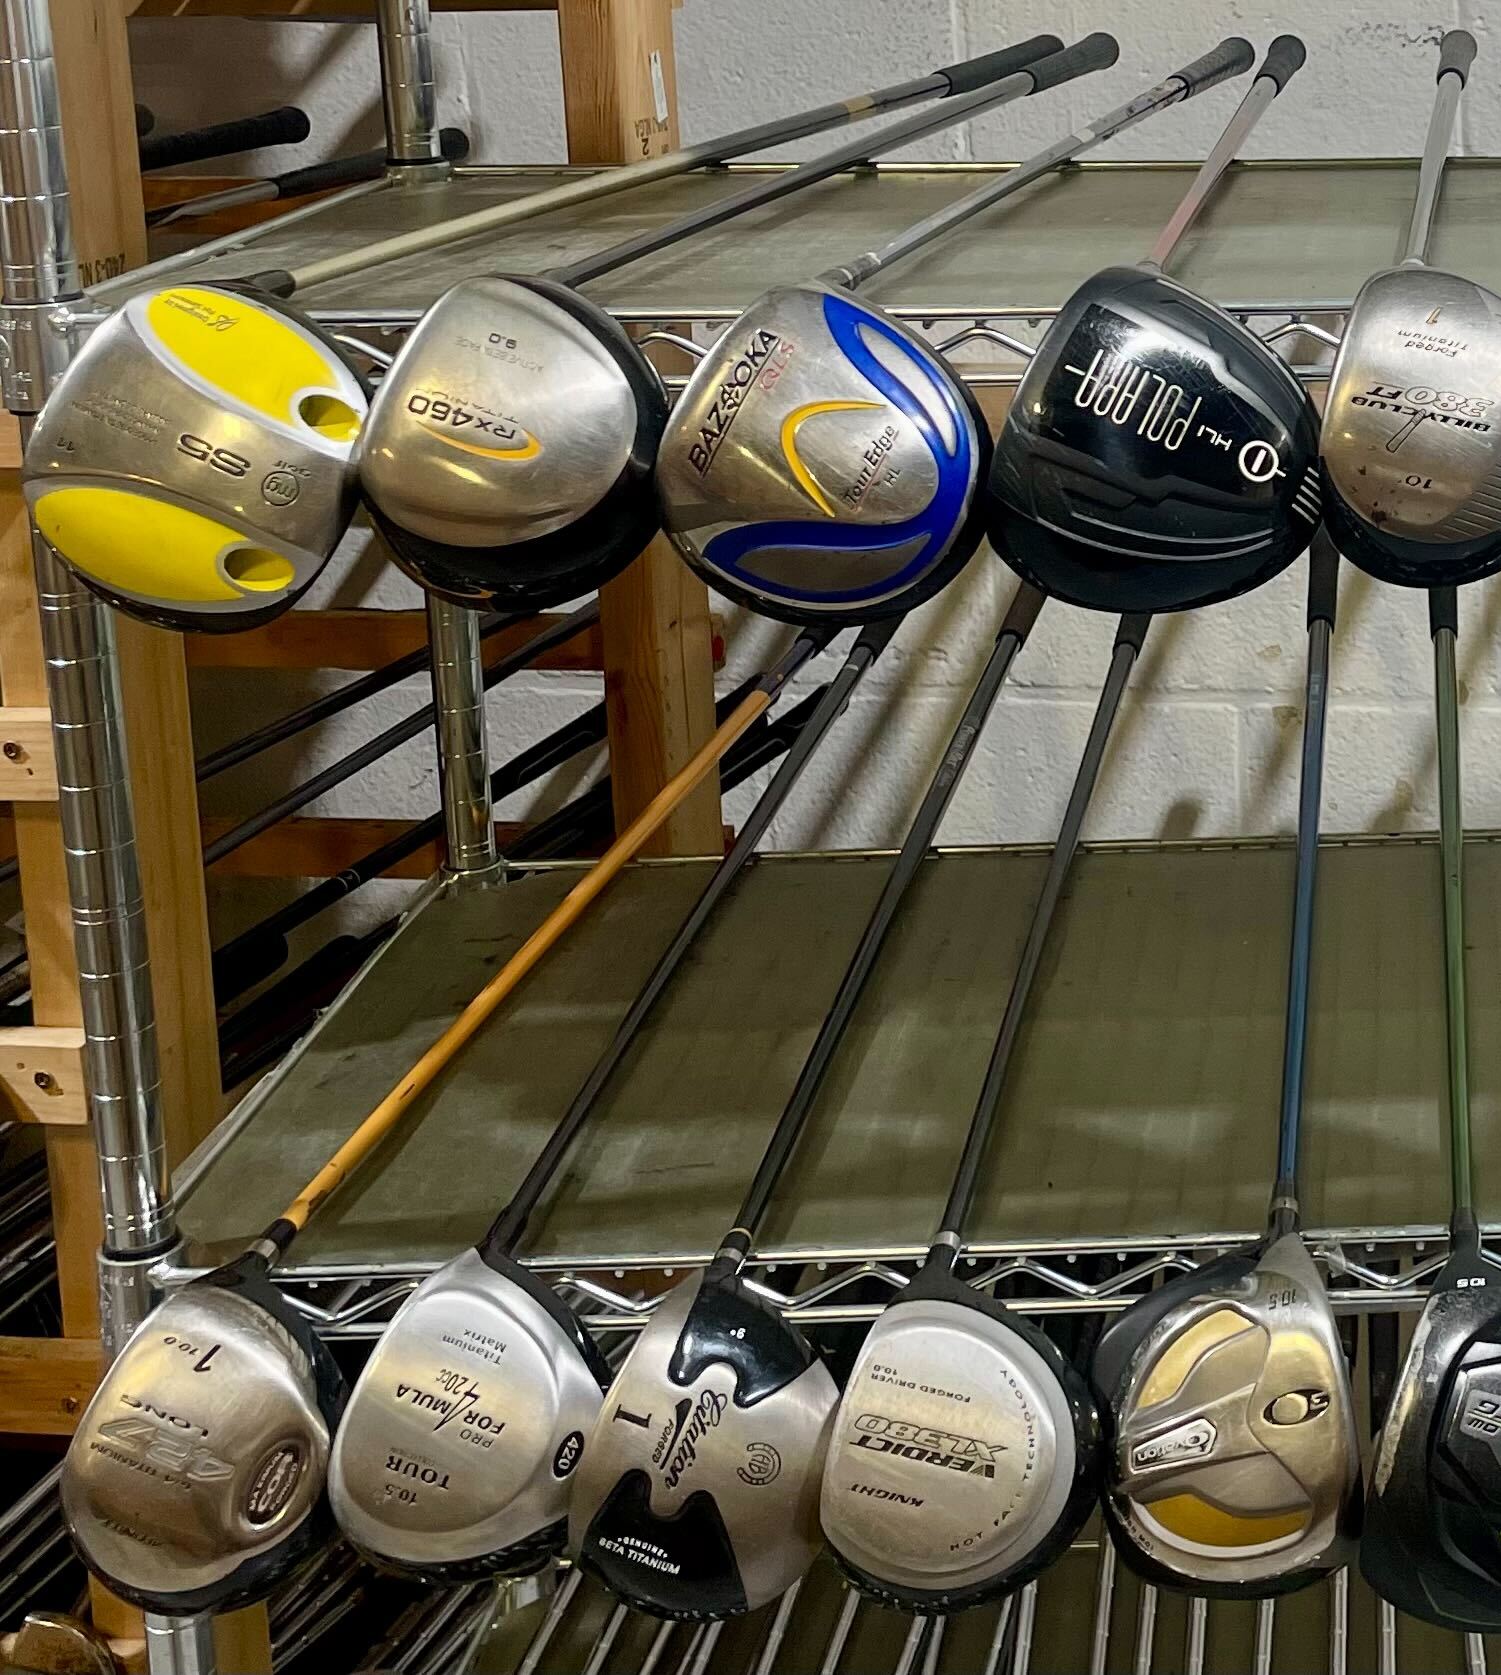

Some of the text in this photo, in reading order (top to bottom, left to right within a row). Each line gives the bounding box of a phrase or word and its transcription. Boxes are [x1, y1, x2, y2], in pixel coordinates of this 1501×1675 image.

[488, 332, 517, 349] 9.0
[1398, 329, 1470, 351] Titanium
[1404, 341, 1458, 357] Forged
[407, 393, 516, 441] RX460
[1074, 349, 1203, 451] POLARA
[1404, 385, 1495, 418] 380
[177, 433, 251, 478] SS
[440, 1334, 503, 1366] Titanium
[463, 1328, 508, 1353] Matrix
[870, 1372, 971, 1404] FORGED DRIVER
[119, 1393, 209, 1438] LONG
[459, 1427, 495, 1450] PRO
[556, 1435, 580, 1471] 420
[650, 1418, 675, 1465] FORGED
[853, 1413, 1009, 1463] XL380
[384, 1453, 450, 1491] TOUR
[849, 1434, 996, 1480] VERDICT
[849, 1483, 924, 1508] KNIGHT
[598, 1536, 681, 1576] BETA TITANIUM
